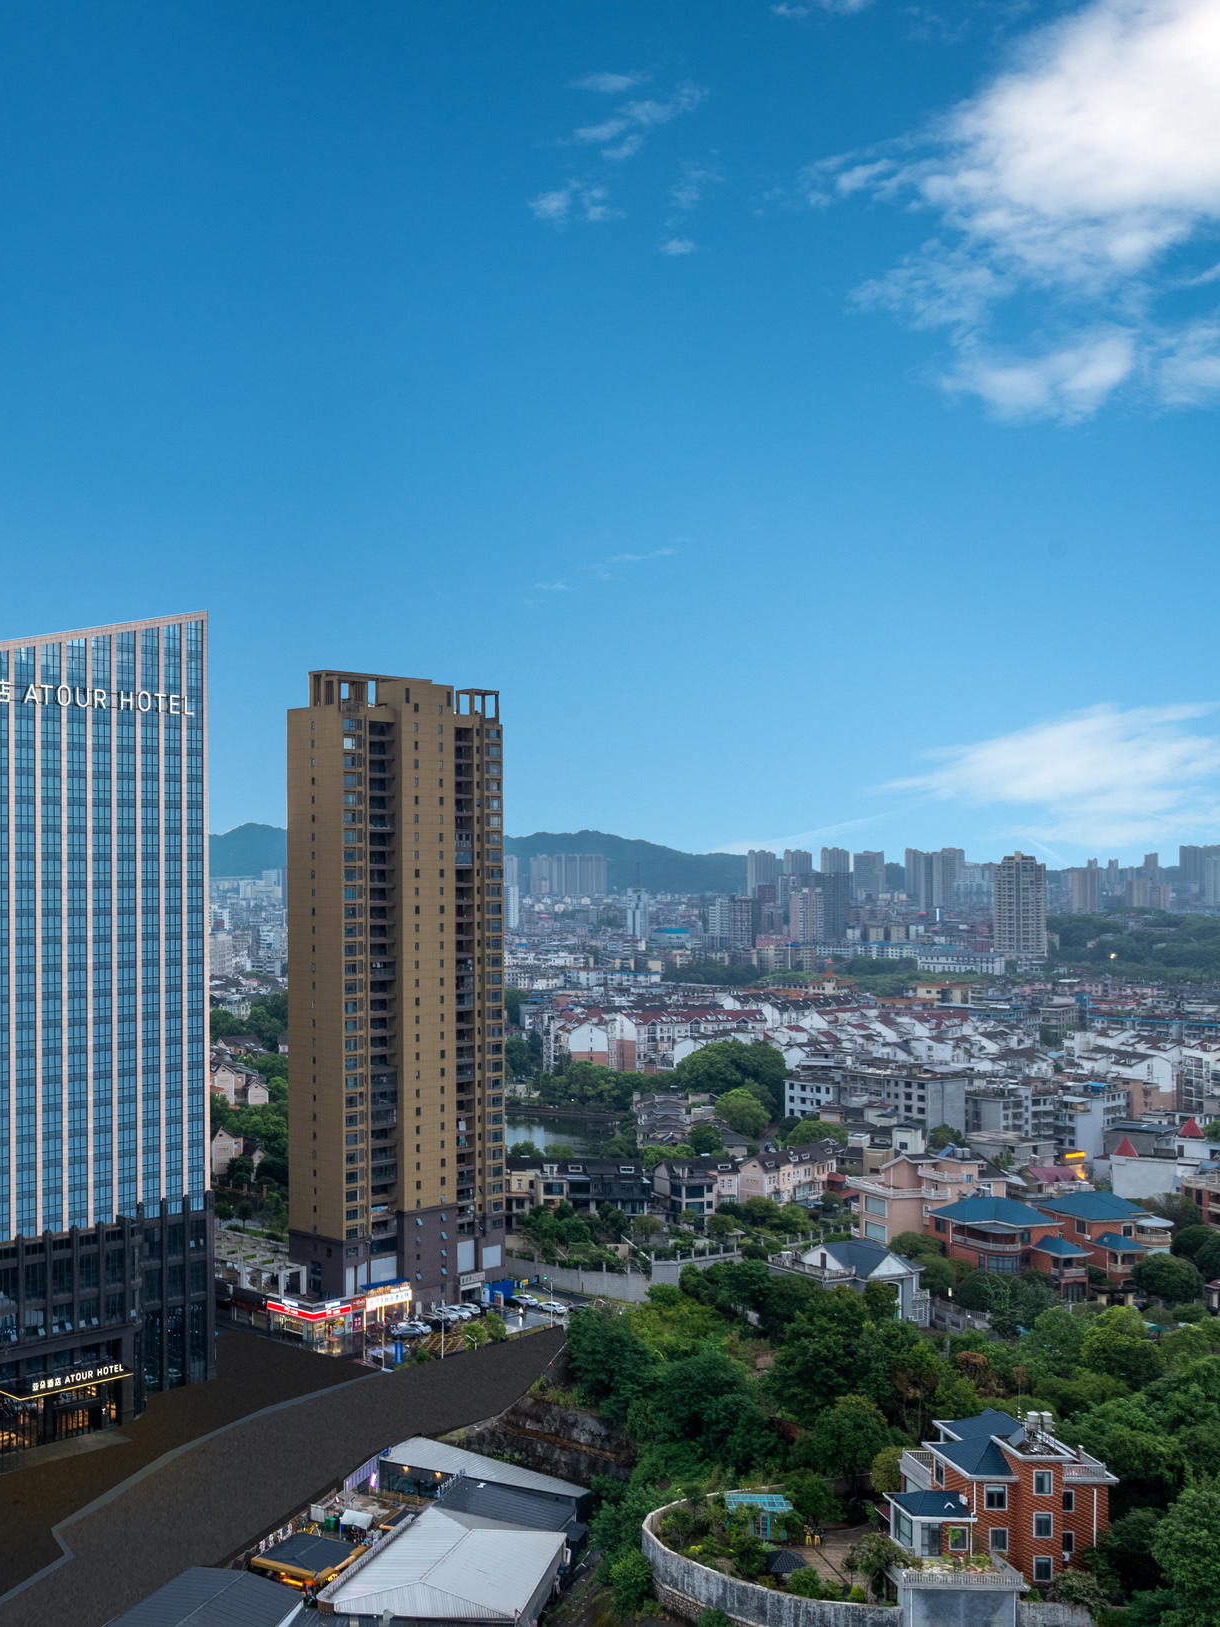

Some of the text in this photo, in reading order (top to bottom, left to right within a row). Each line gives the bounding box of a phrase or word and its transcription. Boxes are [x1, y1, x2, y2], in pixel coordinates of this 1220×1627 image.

[24, 683, 107, 709] ATOUR
[119, 690, 195, 715] HOTEL
[32, 1363, 124, 1392] 亚朵酒店 ATOUR HOTEL
